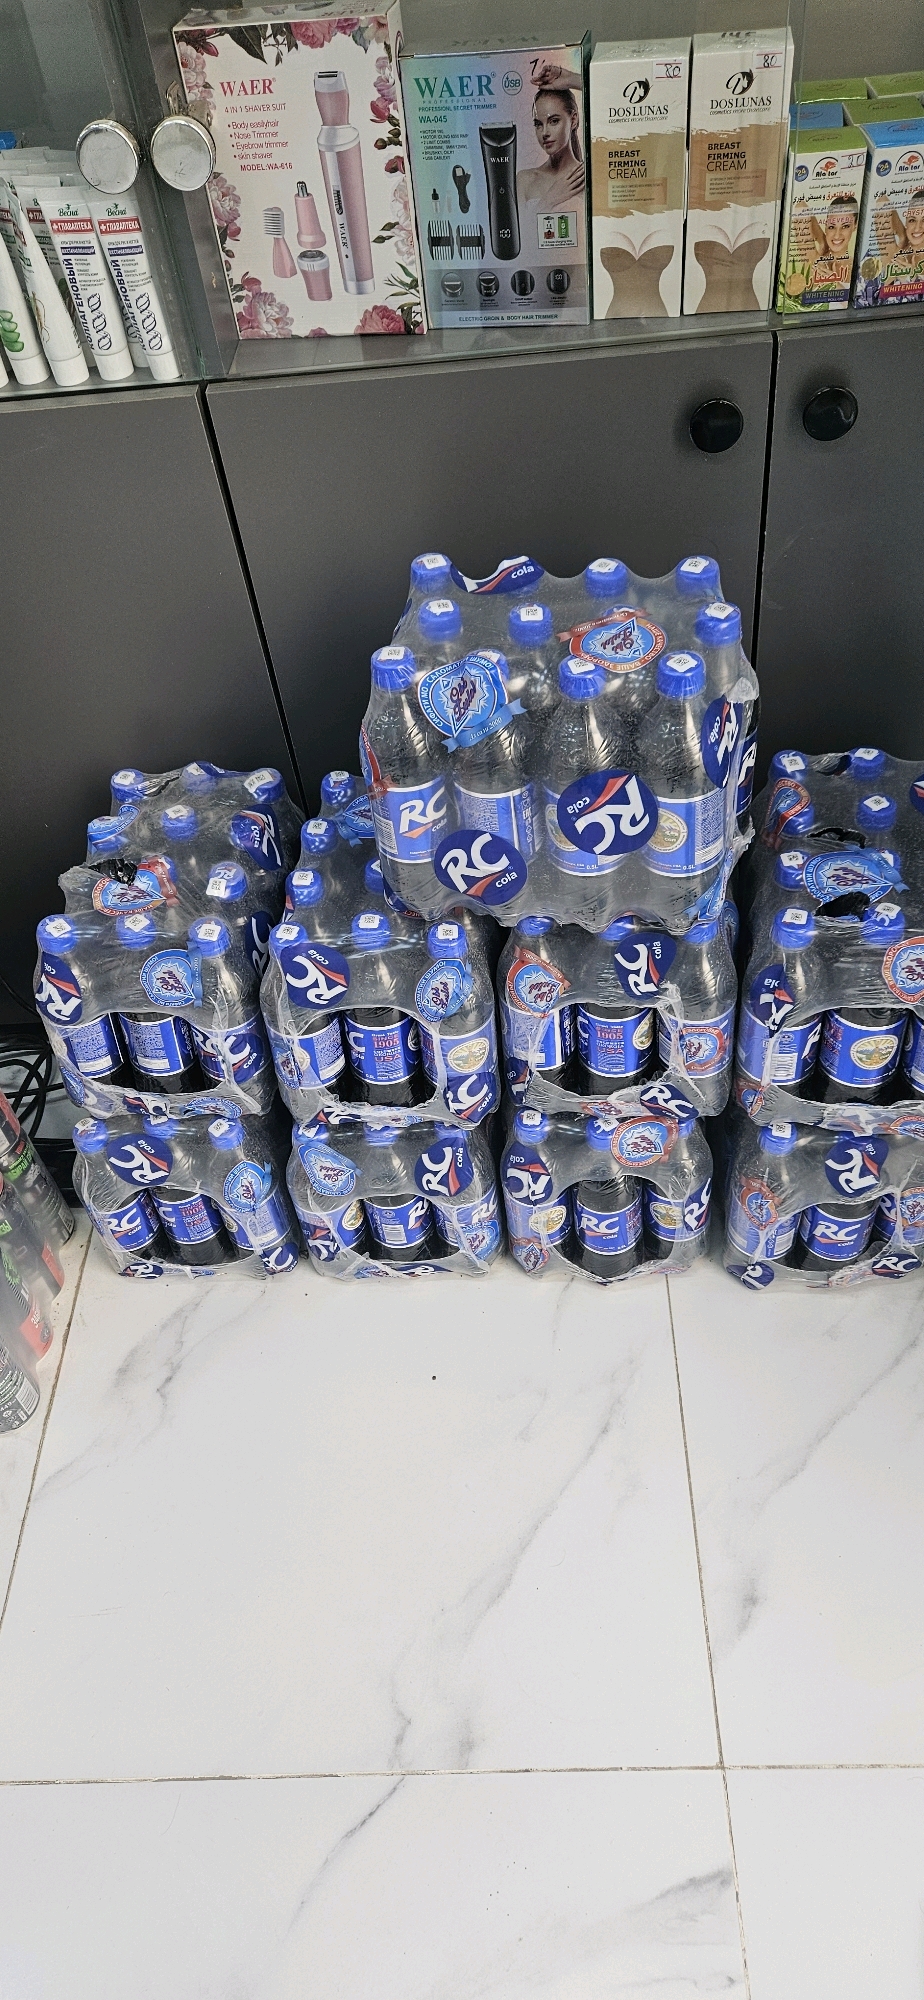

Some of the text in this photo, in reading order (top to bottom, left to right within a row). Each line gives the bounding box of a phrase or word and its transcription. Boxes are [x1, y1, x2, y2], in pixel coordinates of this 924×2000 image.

[763, 54, 777, 68] 80
[664, 63, 681, 79] 80
[219, 78, 274, 97] WAER
[413, 74, 495, 99] WAER
[504, 78, 521, 88] USB
[244, 104, 271, 112] SHAVER
[271, 102, 287, 111] SUIT
[710, 95, 772, 110] DOS LUNAS
[609, 104, 669, 118] DOS LUNAS
[231, 121, 248, 130] Body
[418, 115, 448, 124] WA-045
[233, 130, 279, 140] Nose Trimmer
[235, 140, 289, 151] Eyebrow trimmer
[707, 141, 741, 151] BREAST
[237, 151, 273, 160] skin shaver
[608, 150, 641, 158] BREAST
[707, 151, 746, 160] FIRMING
[608, 160, 646, 168] FIRMING
[706, 159, 747, 172] CREAM
[608, 168, 647, 179] CREAM
[805, 290, 845, 299] WHITENING
[883, 283, 923, 293] WHITENING
[62, 258, 95, 350] КОЛЛАГЕНОВЫЙ
[511, 564, 535, 579] cola
[708, 716, 721, 745] cola
[399, 787, 447, 834] RC
[566, 796, 591, 814] cola
[574, 774, 650, 855] RC
[431, 818, 448, 832] cola
[440, 832, 511, 894] RC
[495, 871, 518, 888] cola
[307, 949, 329, 965] cola
[654, 941, 662, 959] cola
[614, 944, 658, 996] RC
[286, 955, 347, 1004] RC
[597, 1031, 624, 1039] 1905
[374, 1039, 399, 1048] 1905
[597, 1046, 624, 1054] USA
[243, 1052, 258, 1069] cola
[374, 1054, 401, 1062] USA
[477, 1092, 493, 1112] cola
[641, 1083, 695, 1118] RC
[137, 1139, 156, 1154] cola
[108, 1145, 170, 1184] RC
[456, 1147, 464, 1168] cola
[510, 1154, 525, 1163] cola
[421, 1146, 453, 1196] RC
[825, 1149, 879, 1193] RC
[506, 1168, 551, 1201] RC
[685, 1177, 711, 1231] RC
[127, 1225, 142, 1236] cola
[581, 1214, 620, 1234] RC
[813, 1221, 861, 1240] RC
[873, 1256, 918, 1271] RC
